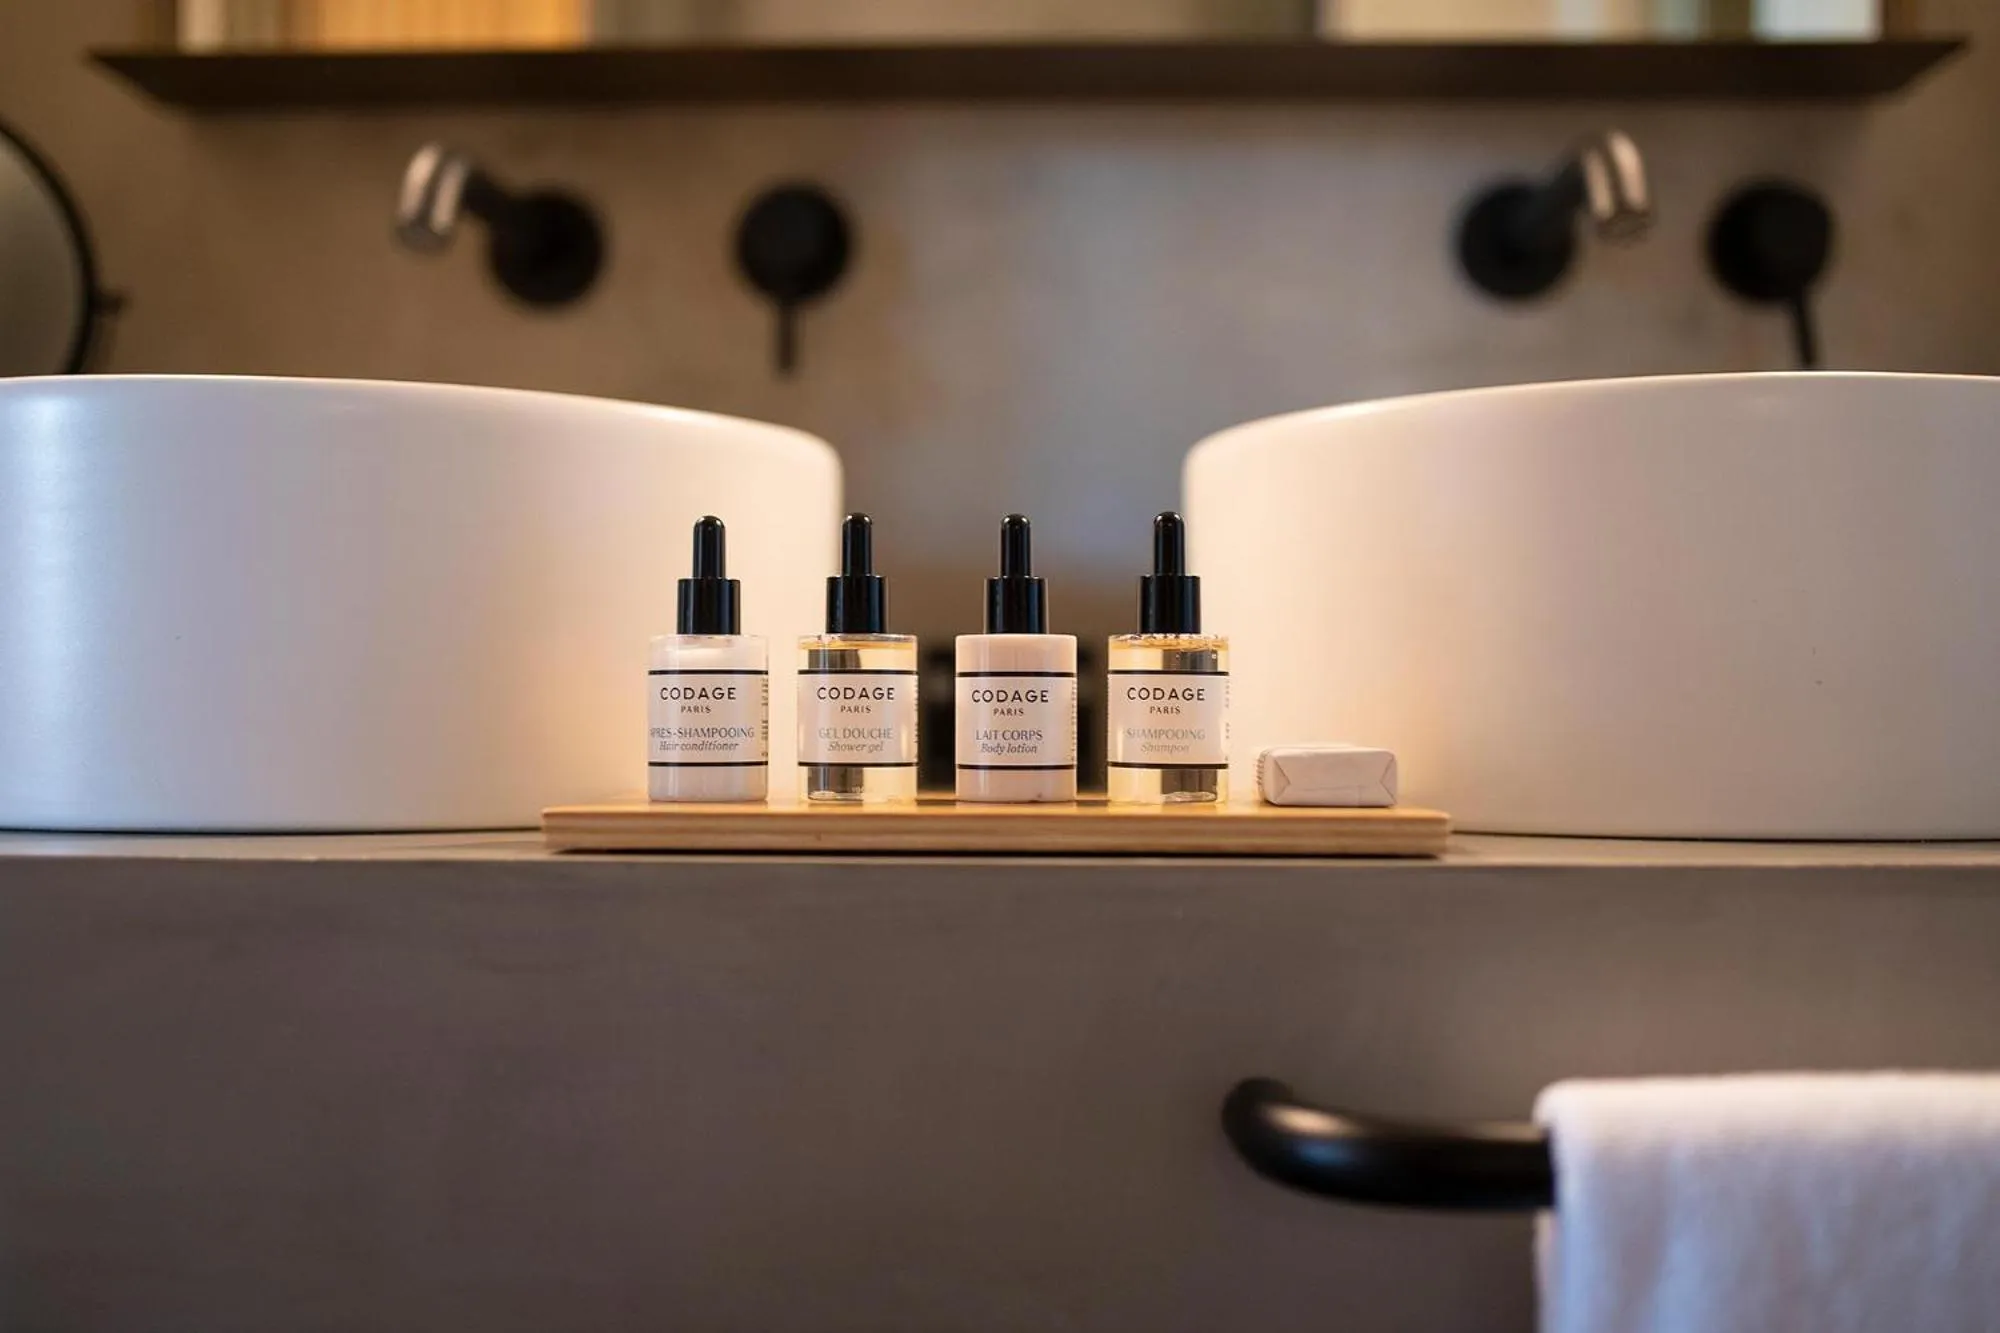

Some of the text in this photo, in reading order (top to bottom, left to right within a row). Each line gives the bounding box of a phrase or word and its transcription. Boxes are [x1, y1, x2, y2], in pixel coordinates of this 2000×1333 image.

[660, 687, 737, 701] CODAGE
[816, 687, 896, 701] CODAGE
[971, 689, 1049, 703] CODAGE
[1127, 687, 1206, 701] CODAGE
[680, 705, 712, 714] PARIS
[840, 705, 872, 714] PARIS
[993, 707, 1025, 717] PARIS
[1149, 705, 1182, 715] PARIS
[818, 727, 894, 739] GEL DOUCHE
[975, 729, 1044, 741] LAIT CORPS
[1126, 727, 1206, 740] SHAMPOOING
[659, 740, 740, 752] Hair conditioner
[827, 741, 884, 754] Shower gel
[980, 742, 1038, 756] Body lotion
